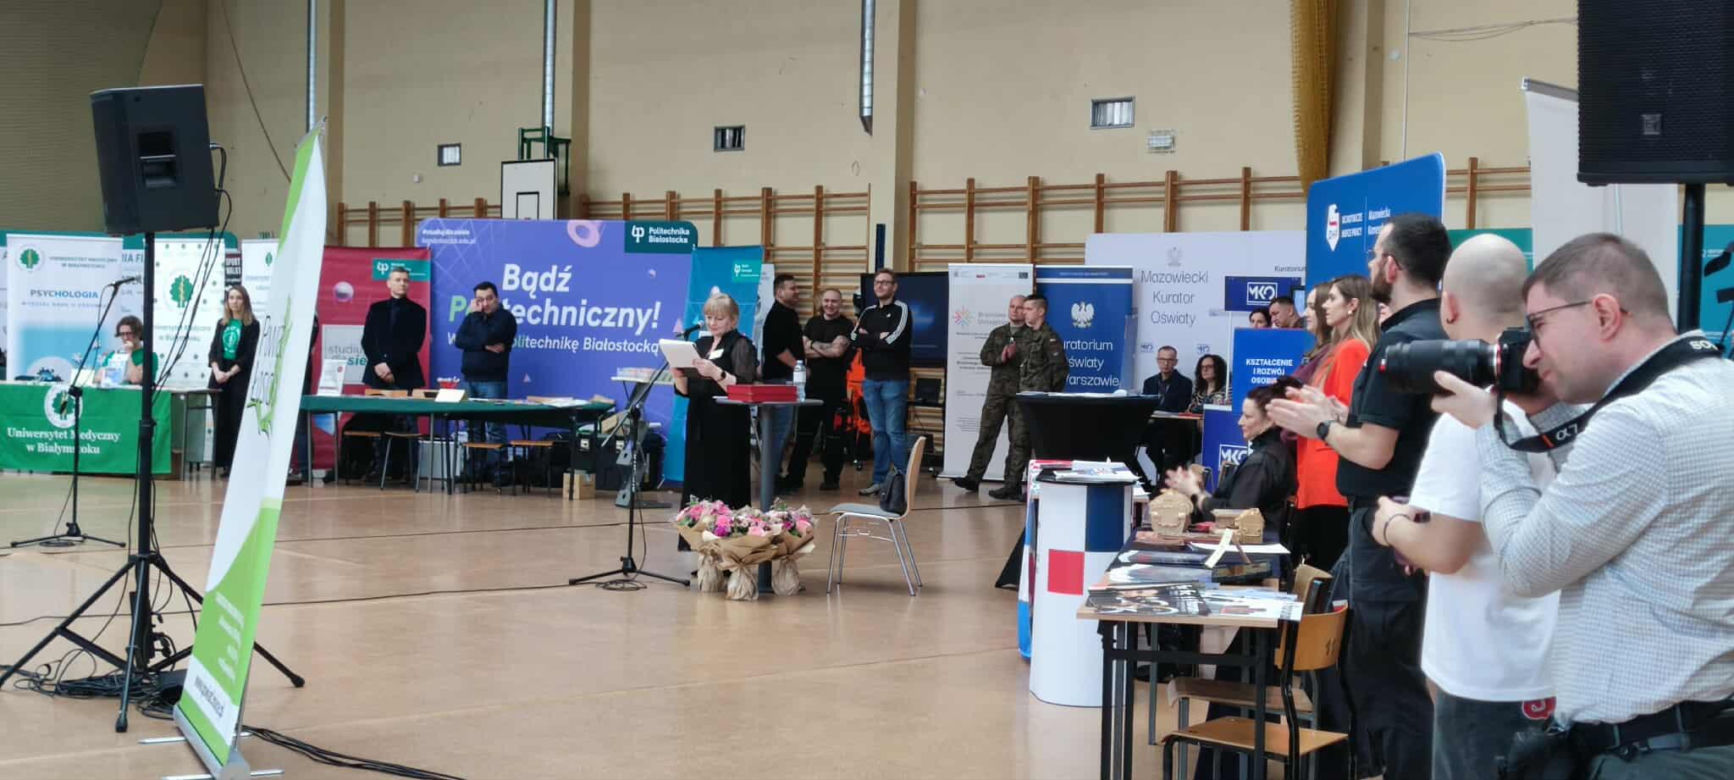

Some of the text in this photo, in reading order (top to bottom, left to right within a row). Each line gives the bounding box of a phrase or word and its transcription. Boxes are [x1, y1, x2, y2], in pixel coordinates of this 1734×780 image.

[648, 227, 690, 236] Politechnika
[648, 235, 688, 243] Białostocka
[502, 263, 572, 299] Bądź
[1141, 271, 1208, 284] Mazowiecki
[30, 289, 99, 299] PSYCHOLOGIA
[1152, 291, 1195, 304] Kurator
[1249, 285, 1276, 300] MKO
[448, 295, 662, 336] Ptechniczny!
[1151, 310, 1196, 327] Oświaty
[511, 334, 660, 356] olitechnikę Białostocką
[1063, 339, 1113, 351] ratorium
[1689, 339, 1718, 352] SO
[347, 357, 367, 366] sie
[1068, 356, 1104, 372] światy
[1245, 358, 1293, 367] KSZTAŁCENIE
[1256, 366, 1285, 376] ROZWÓJ
[7, 427, 67, 441] Uniwersytet
[26, 442, 101, 455] w Białymsoku
